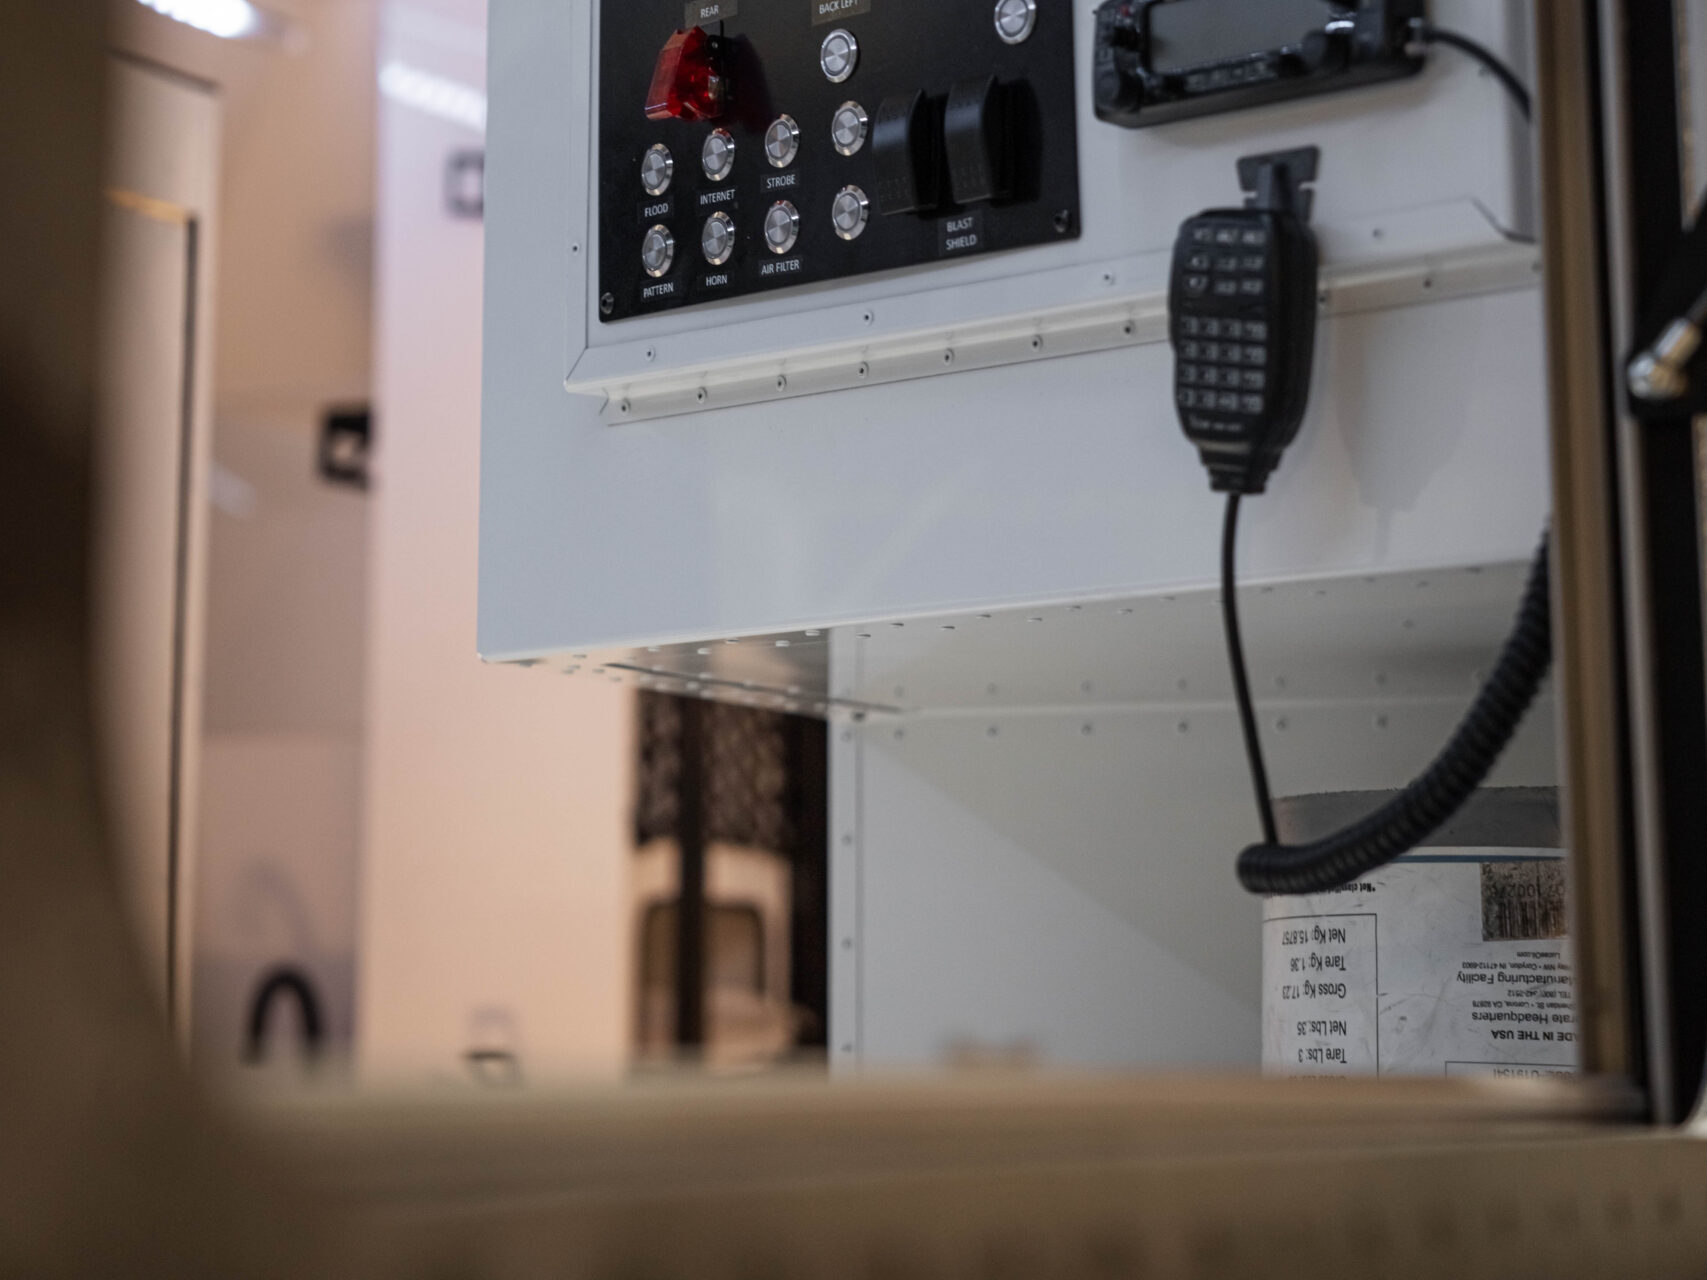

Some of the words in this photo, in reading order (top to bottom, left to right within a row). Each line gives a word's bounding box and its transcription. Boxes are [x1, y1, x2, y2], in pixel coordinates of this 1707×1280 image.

[700, 4, 719, 19] REAR
[819, 0, 839, 15] BACK
[767, 174, 796, 189] STROBE
[700, 190, 735, 206] INTERNET
[645, 203, 668, 217] FLOOD
[946, 217, 974, 232] BLAST
[946, 234, 977, 250] SHIELD
[761, 263, 774, 275] AIR
[776, 259, 800, 273] FILTER
[706, 274, 727, 287] HORN
[643, 283, 674, 298] PATTERN
[1282, 928, 1308, 945] 15.8757
[1312, 925, 1326, 942] Kg:
[1328, 928, 1346, 943] Net
[1309, 952, 1322, 970] Kg:
[1325, 955, 1346, 971] Tare
[1457, 971, 1494, 984] Facility
[1282, 985, 1300, 999] 17.23
[1303, 980, 1316, 998] Kg:
[1318, 983, 1346, 998] Gross
[1472, 1011, 1548, 1024] Headquarters
[1297, 1021, 1307, 1035] 35
[1310, 1021, 1327, 1035] Lbs:
[1332, 1021, 1347, 1035] Net
[1491, 1030, 1514, 1039] USA
[1517, 1031, 1540, 1040] THE
[1543, 1031, 1554, 1040] IN
[1298, 1048, 1304, 1062] 3
[1308, 1048, 1323, 1063] Lbs:
[1326, 1048, 1347, 1063] Tare
